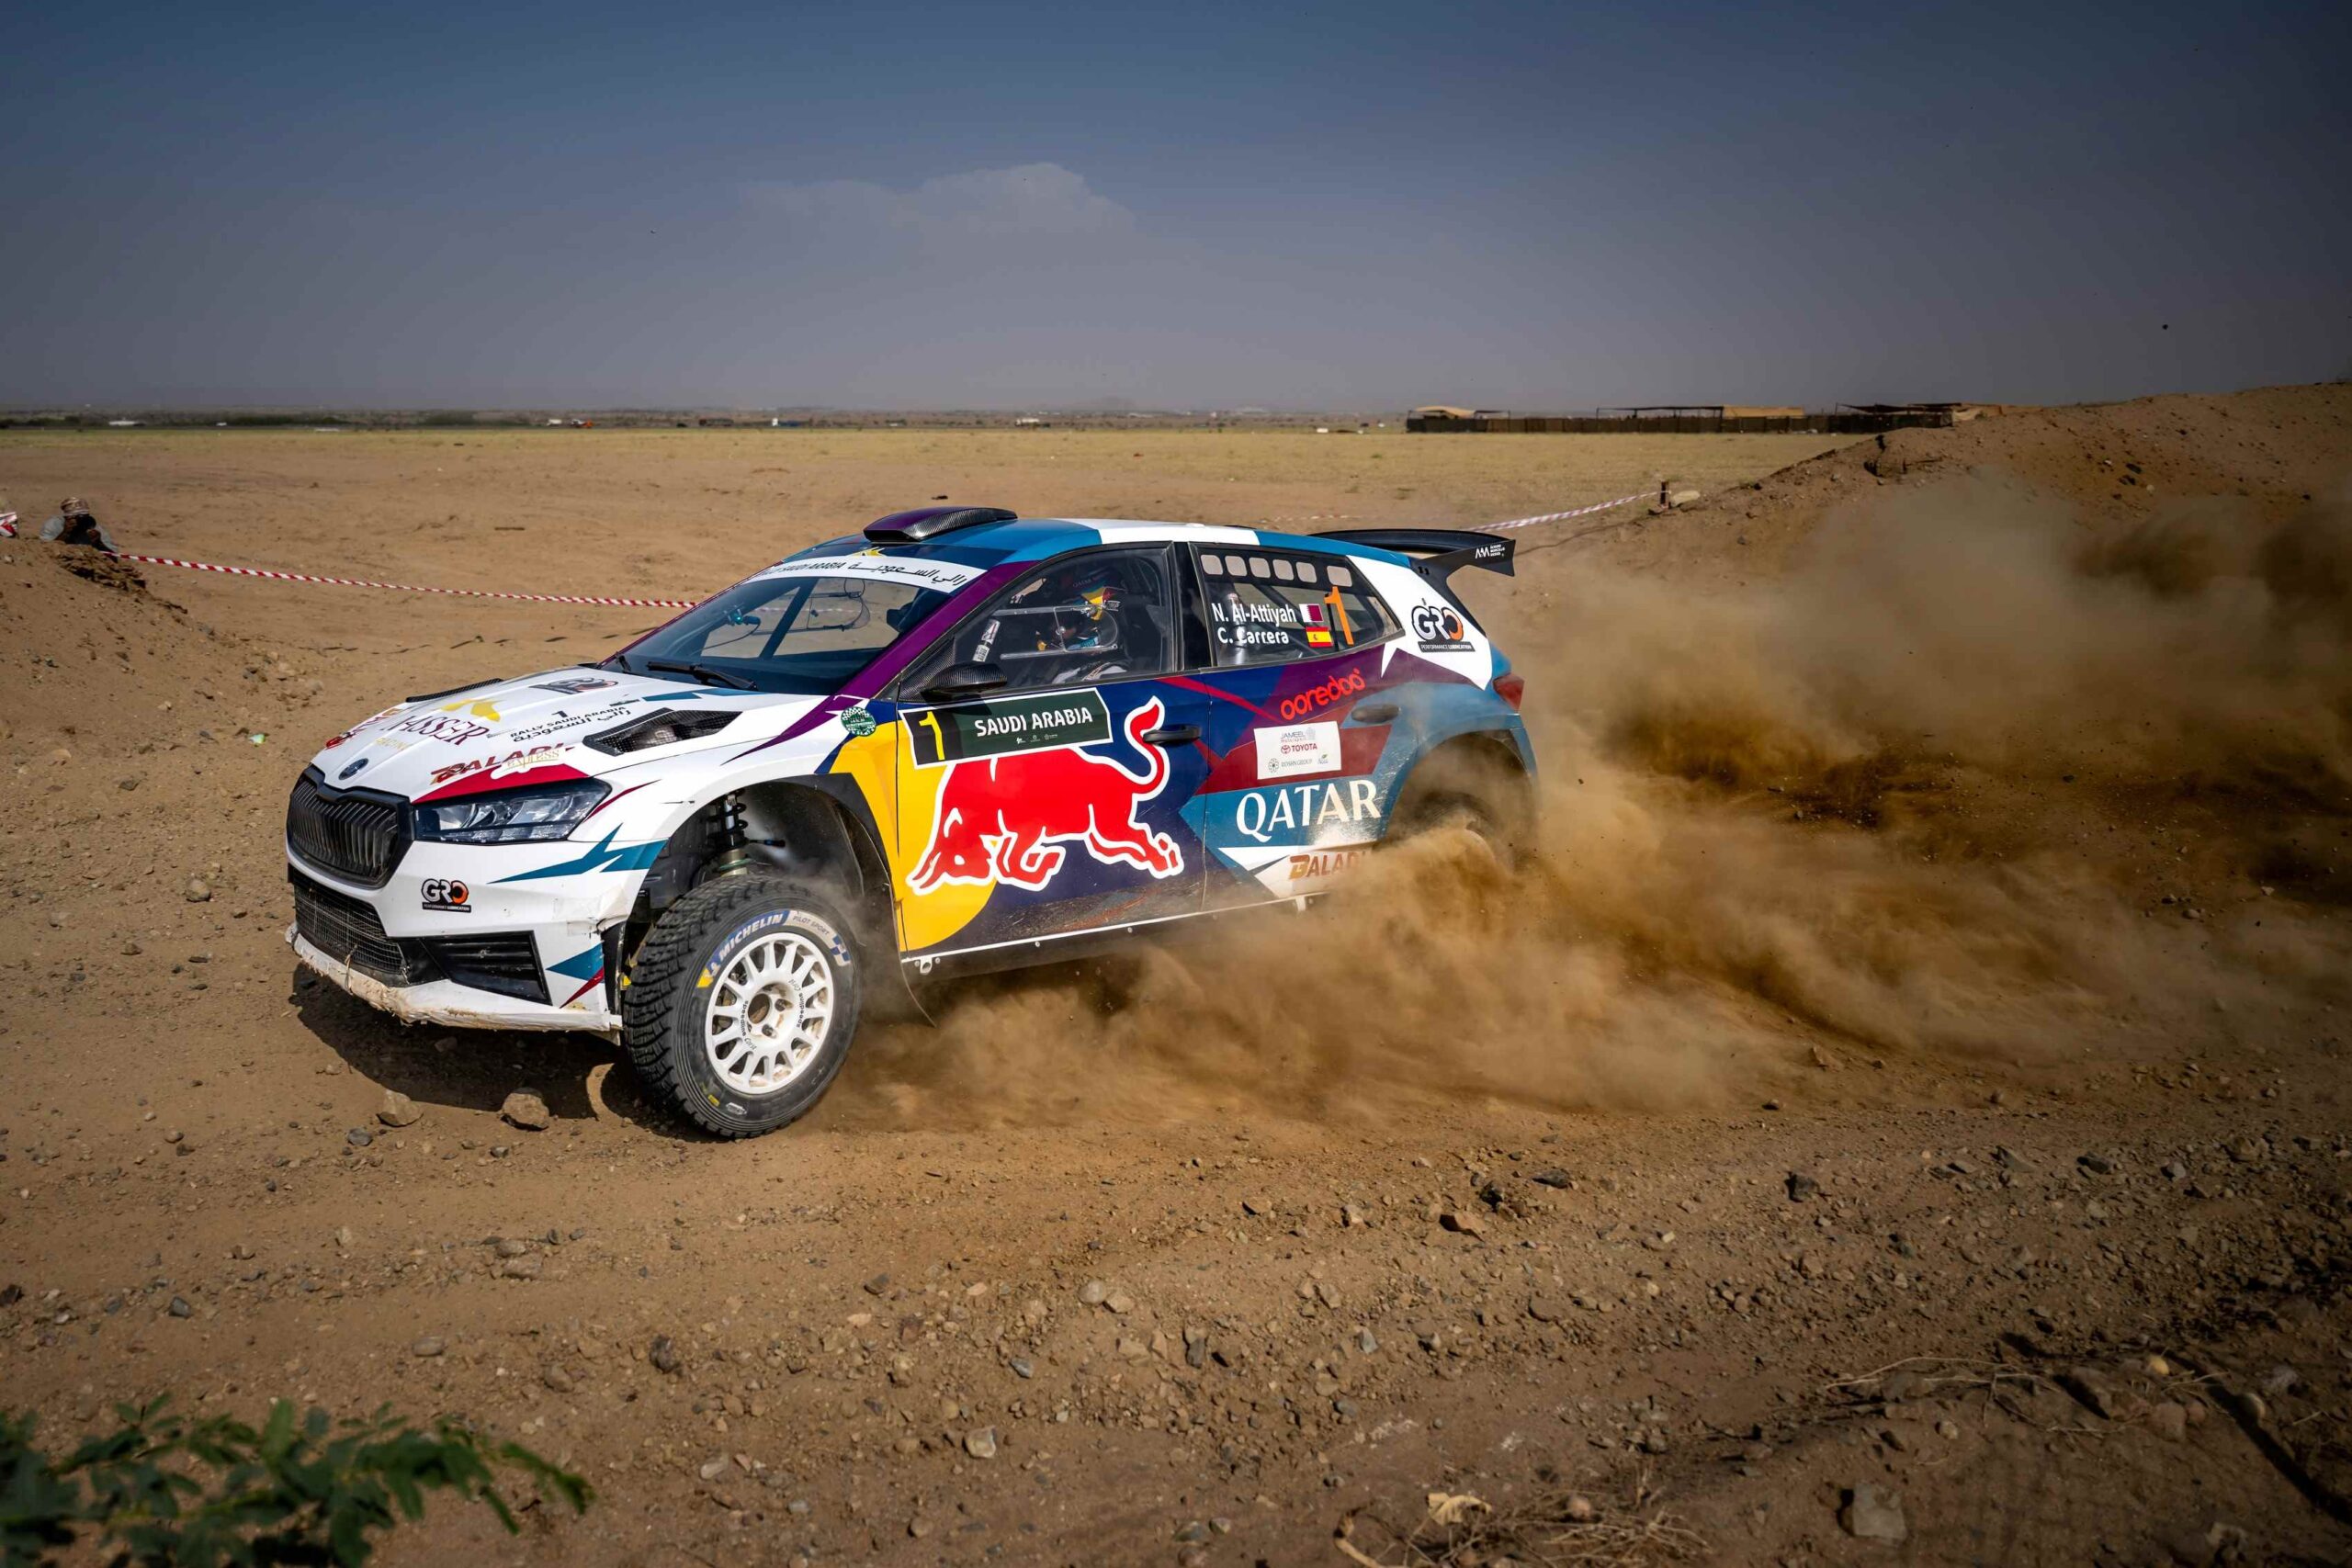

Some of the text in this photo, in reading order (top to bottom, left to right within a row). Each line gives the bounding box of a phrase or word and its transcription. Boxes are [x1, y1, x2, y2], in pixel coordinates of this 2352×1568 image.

[847, 561, 967, 586] رالي السعودية
[1211, 603, 1297, 626] N. Al-Attiyah
[1323, 586, 1354, 646] 1
[1217, 626, 1289, 644] C. Carrera
[1280, 668, 1366, 720] ooredoo
[510, 706, 627, 738] RALLY SAUDI ARABIA
[918, 711, 945, 761] 1
[974, 706, 1093, 738] SAUDI ARABIA
[1291, 742, 1317, 752] TOYOTA
[1236, 779, 1382, 843] QATAR
[421, 878, 469, 904] GRO
[718, 913, 784, 961] MICHELIN
[792, 915, 830, 935] PILOT SPORT
